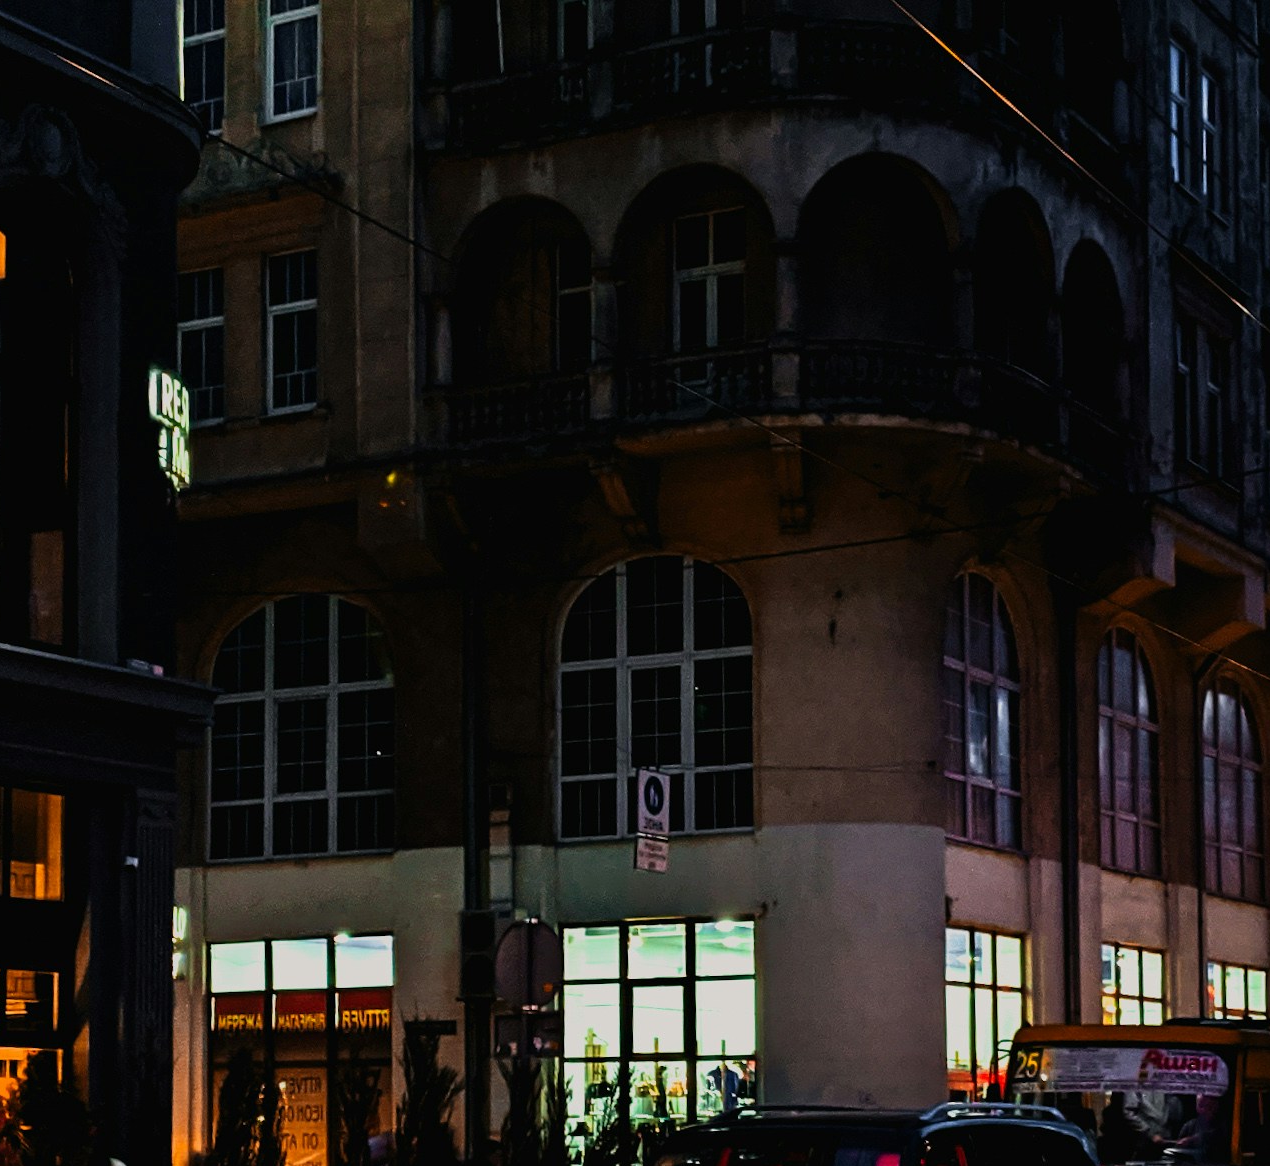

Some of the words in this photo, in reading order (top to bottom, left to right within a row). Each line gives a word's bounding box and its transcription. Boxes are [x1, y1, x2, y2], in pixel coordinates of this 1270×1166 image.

[218, 1013, 264, 1031] МЕРЕЖА
[341, 1009, 390, 1031] ВЗУТТЯ
[1014, 1050, 1040, 1078] 25
[1140, 1048, 1218, 1073] Ашан
